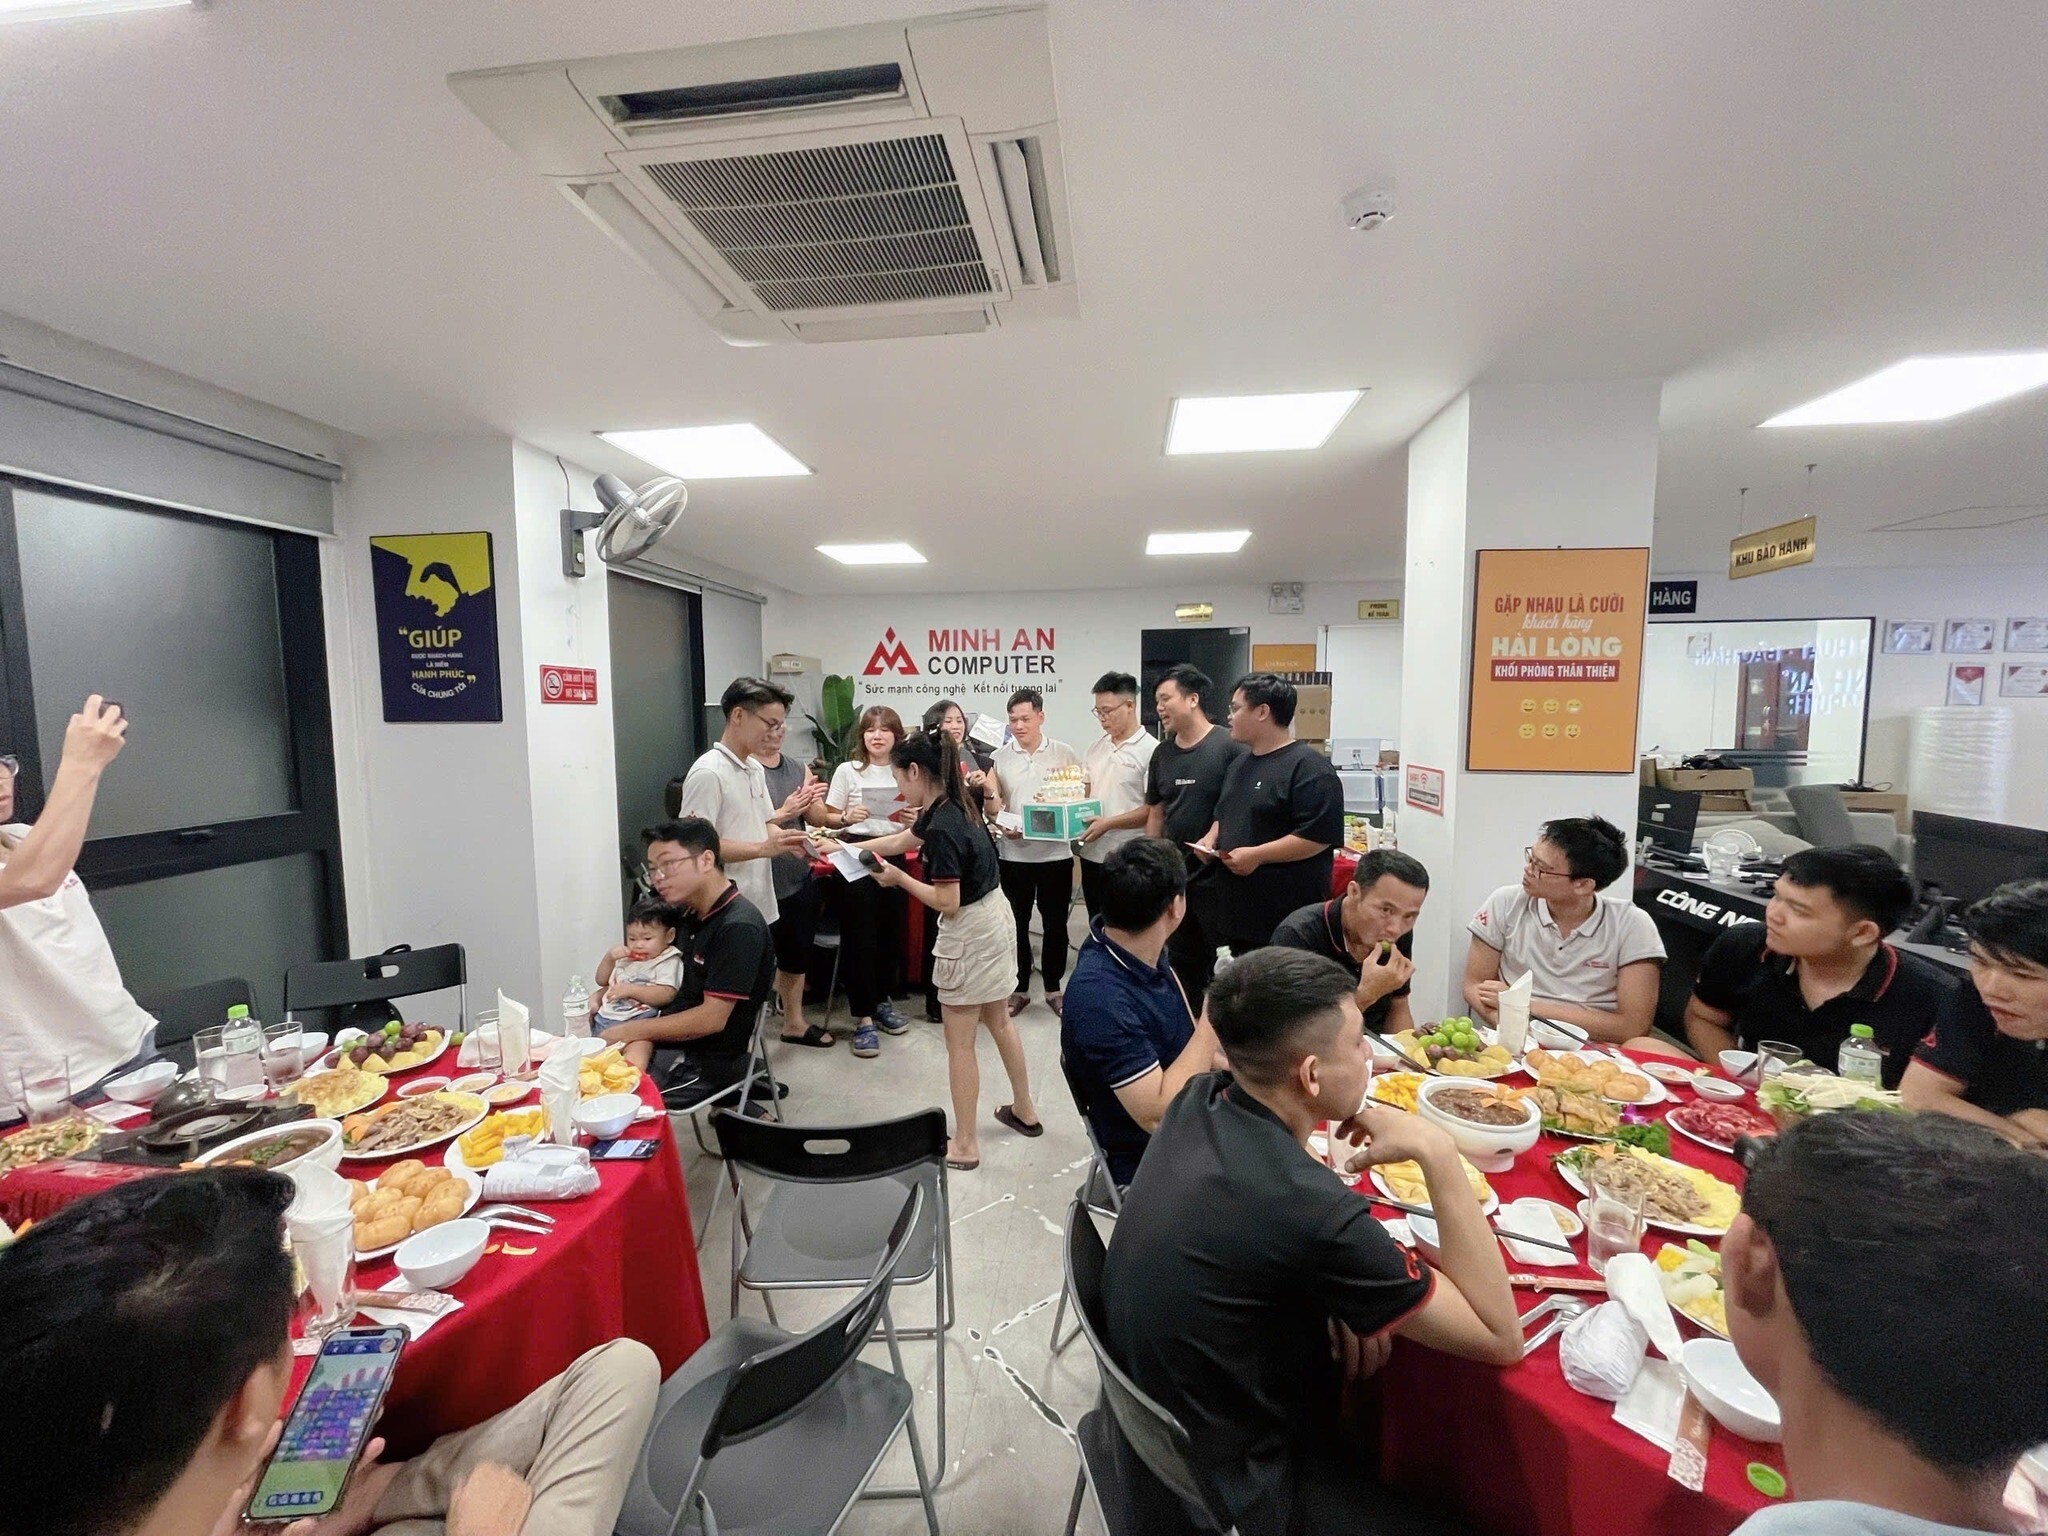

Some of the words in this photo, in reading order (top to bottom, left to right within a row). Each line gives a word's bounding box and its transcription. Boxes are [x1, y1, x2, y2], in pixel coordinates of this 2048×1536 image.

[1735, 551, 1754, 567] KHU
[1757, 542, 1776, 561] BẢO
[1495, 595, 1521, 616] GẶP
[1526, 597, 1563, 613] NHAU
[1569, 593, 1584, 612] LÀ
[1590, 593, 1624, 612] CƯỜI
[1653, 587, 1691, 605] HÀNG
[1523, 614, 1558, 629] khách
[1562, 614, 1593, 632] hàng
[928, 628, 1000, 652] MINH
[1011, 628, 1055, 651] AN
[1491, 634, 1536, 657] HÀI
[1546, 632, 1623, 657] LÒNG
[411, 670, 437, 679] HẠNH
[439, 668, 464, 678] PHÚC
[928, 655, 1055, 675] COMPUTER
[1495, 661, 1518, 677] KHỐI
[1521, 662, 1554, 677] PHÒNG
[1557, 663, 1582, 677] THÂN
[1586, 663, 1615, 680] THIỆN
[411, 683, 426, 695] CỦA
[428, 689, 454, 698] CHÚNG
[887, 684, 913, 695] mạnh
[916, 683, 940, 696] công
[943, 683, 966, 696] nghệ
[973, 681, 990, 694] Kết
[993, 683, 1009, 694] nối
[1656, 889, 1721, 920] CÔNG
[1717, 910, 1761, 928] N
